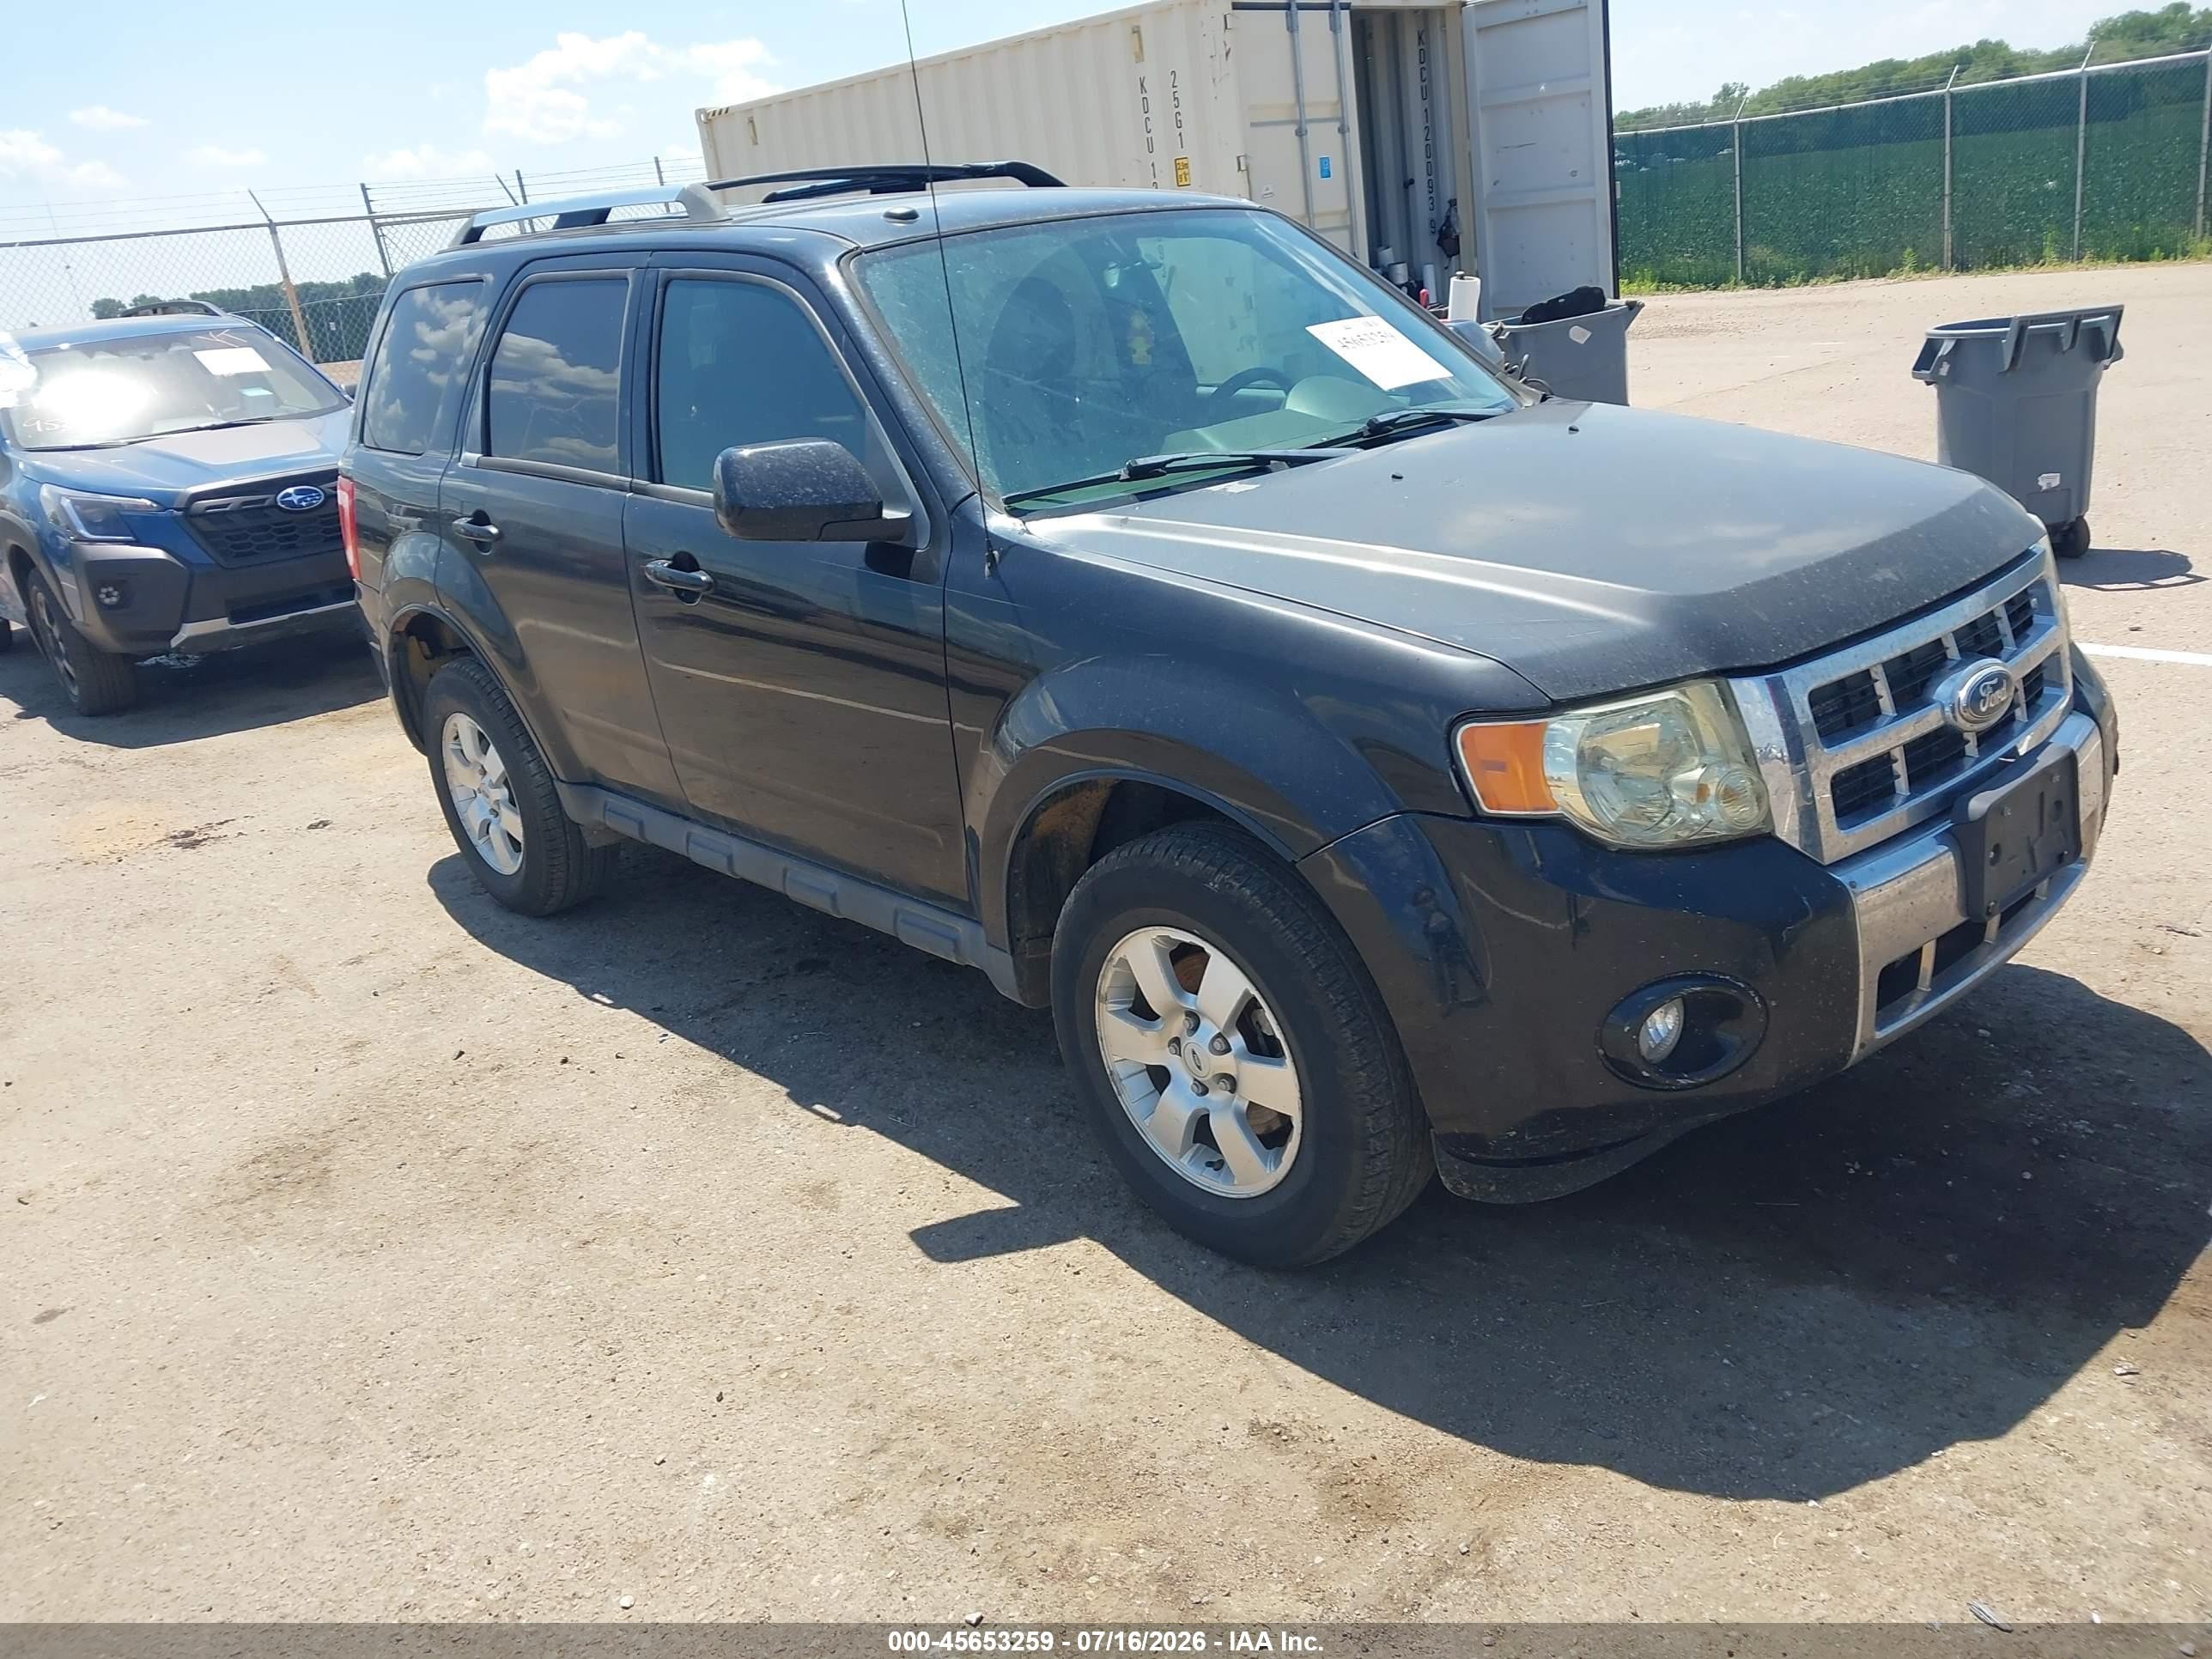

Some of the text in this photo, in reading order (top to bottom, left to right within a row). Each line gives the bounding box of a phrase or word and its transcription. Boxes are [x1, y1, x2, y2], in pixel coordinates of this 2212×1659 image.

[1139, 76, 1154, 154] KDCU
[1170, 70, 1183, 149] 25G1
[1416, 30, 1428, 100] KDCU
[1424, 108, 1435, 211] 120093
[1978, 678, 2007, 713] Ford
